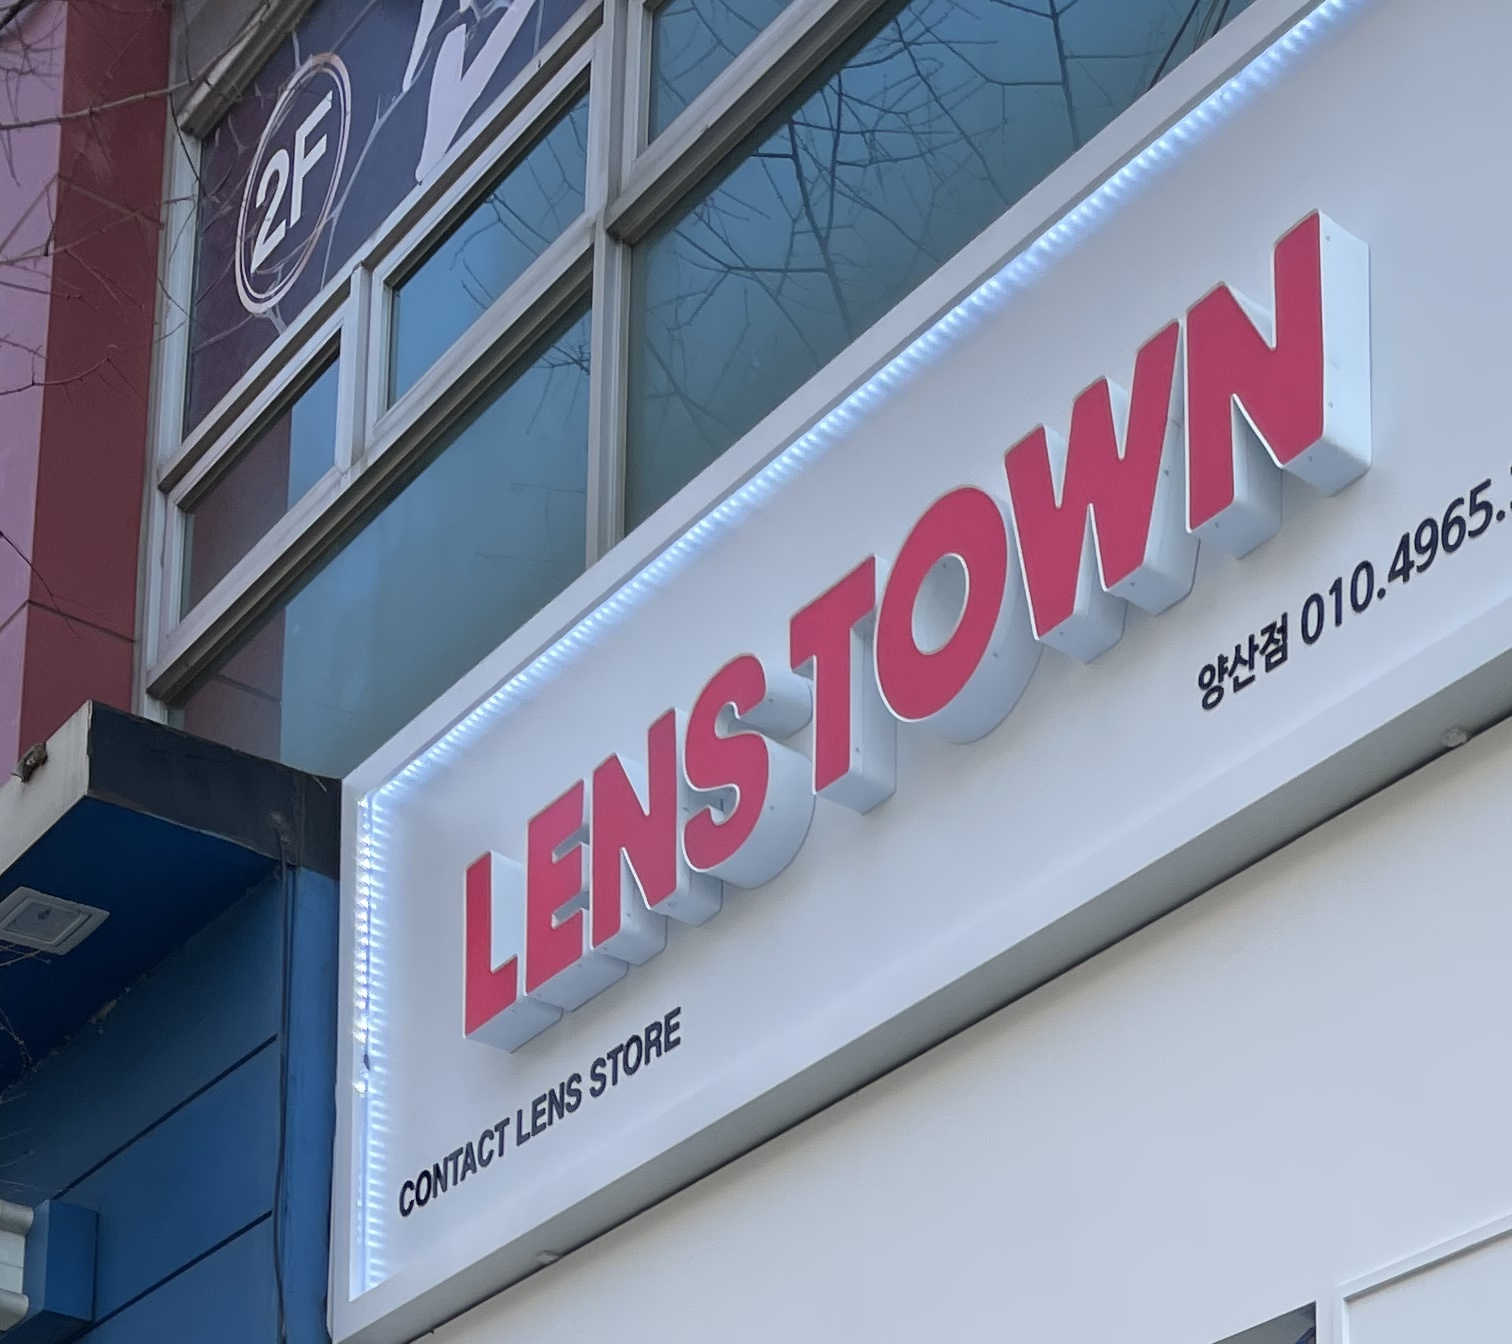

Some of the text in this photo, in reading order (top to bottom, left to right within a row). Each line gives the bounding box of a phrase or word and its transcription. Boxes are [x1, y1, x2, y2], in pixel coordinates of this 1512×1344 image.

[251, 92, 333, 274] 2F
[1198, 613, 1289, 711] 양산점
[398, 1007, 683, 1218] CONTACT LENS STORE
